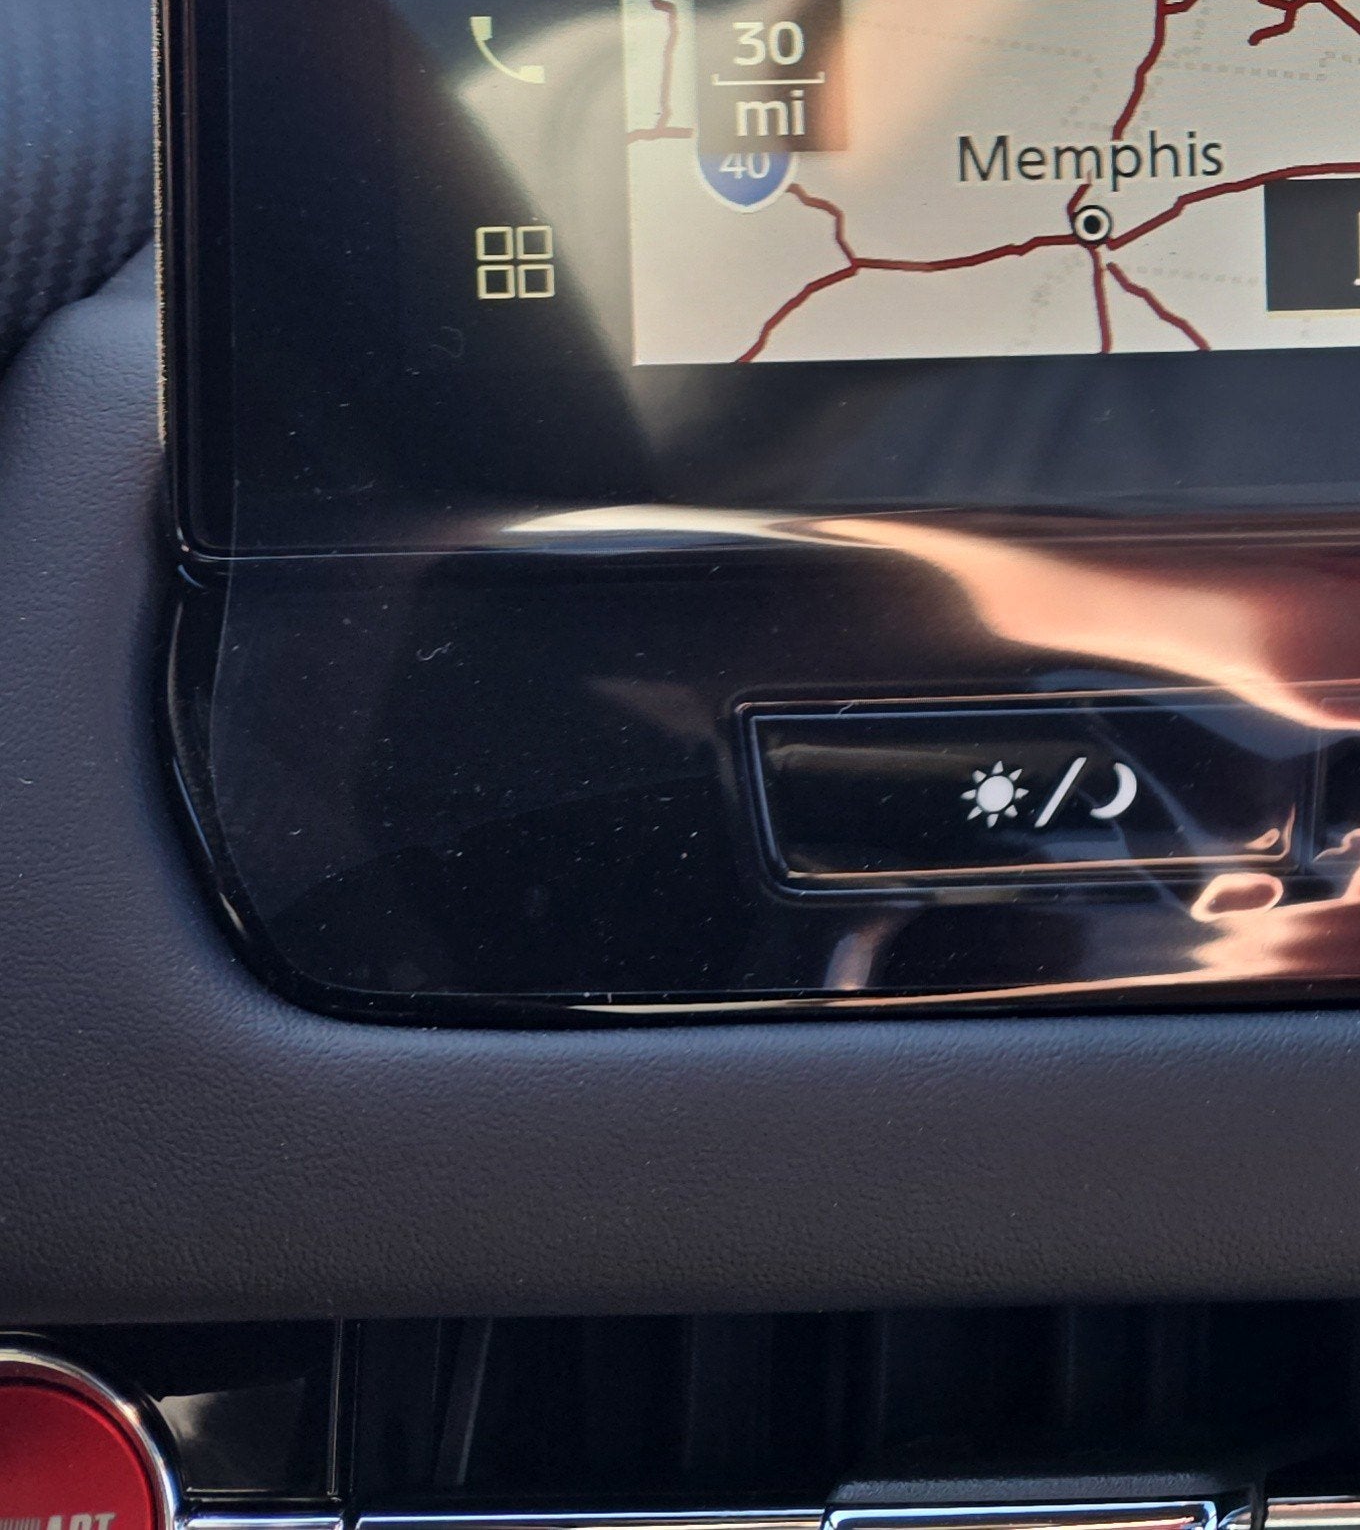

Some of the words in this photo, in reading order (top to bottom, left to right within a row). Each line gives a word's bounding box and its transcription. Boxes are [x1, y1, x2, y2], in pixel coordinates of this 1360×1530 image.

[732, 20, 804, 66] 30
[735, 89, 806, 137] mi
[958, 131, 1224, 192] Memphis
